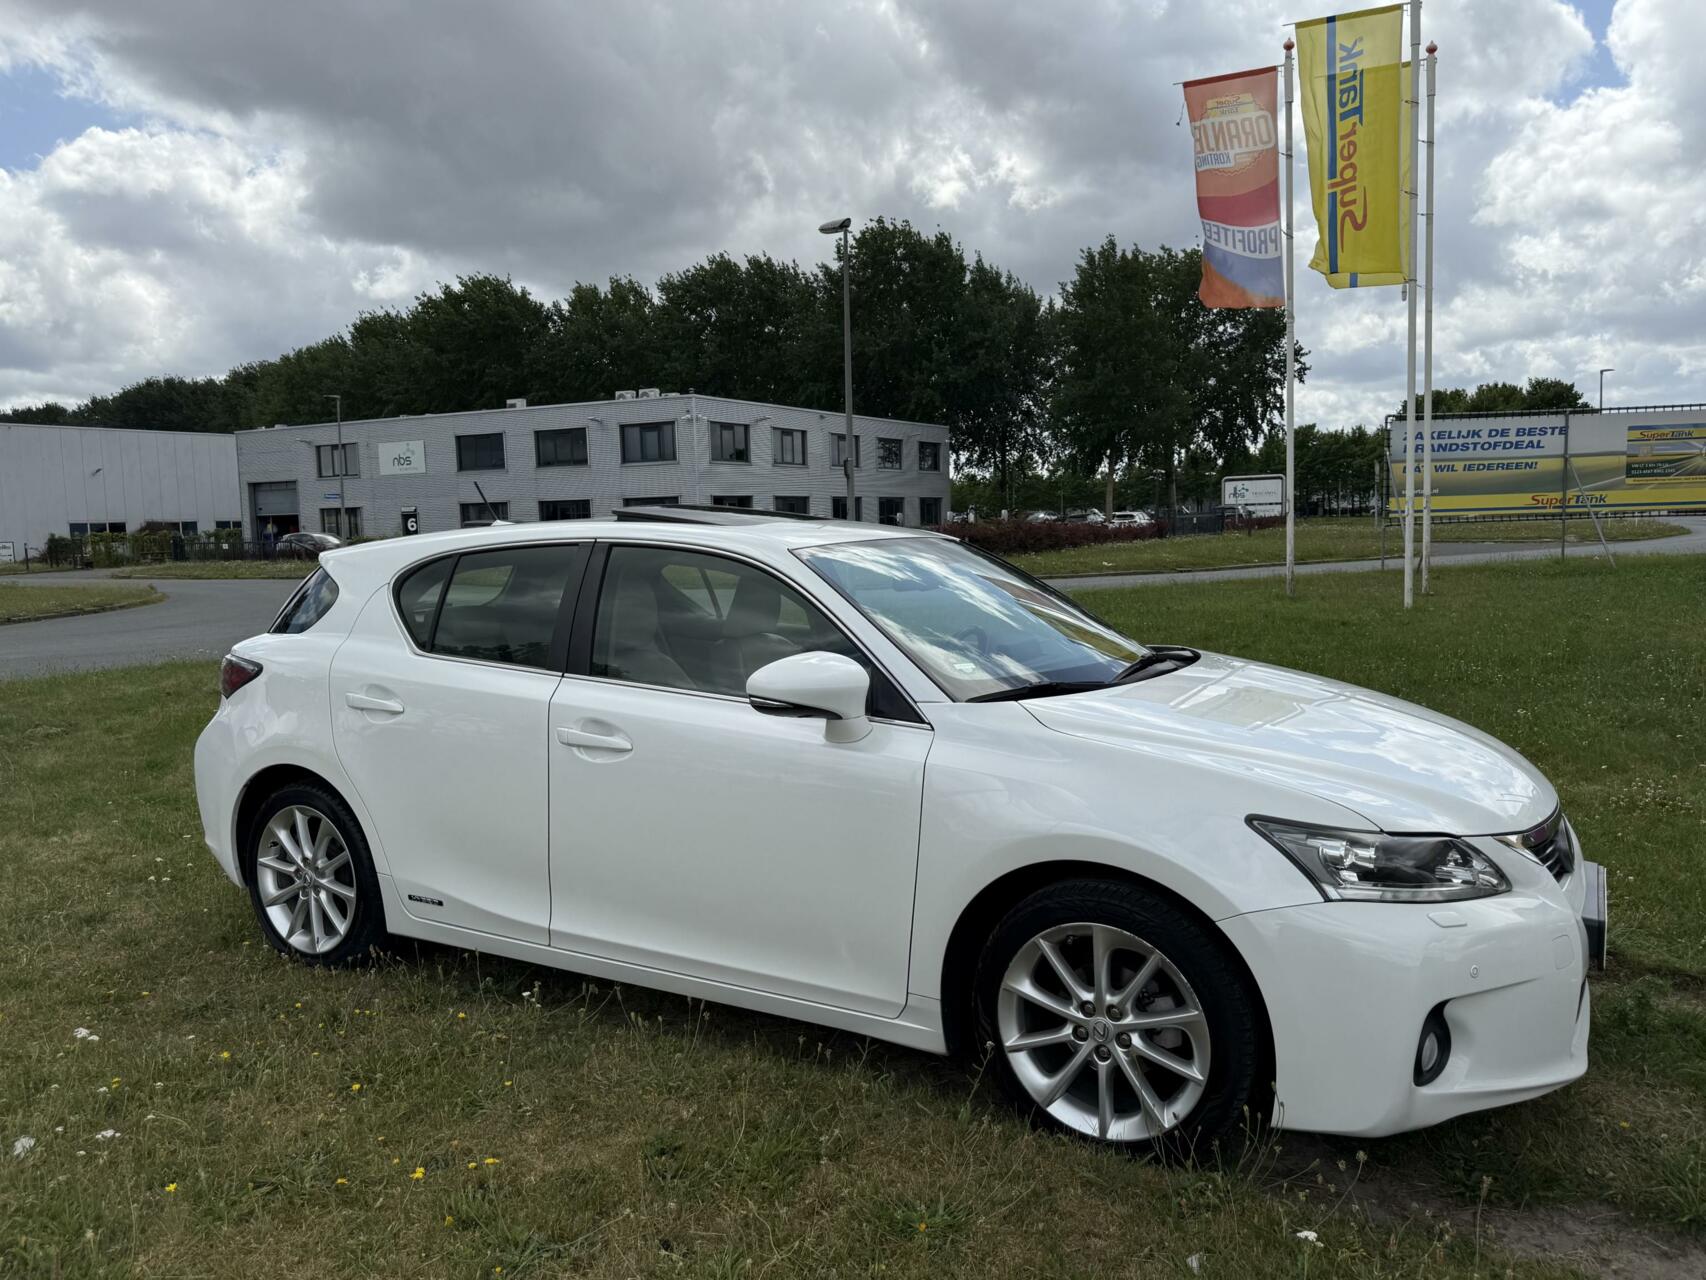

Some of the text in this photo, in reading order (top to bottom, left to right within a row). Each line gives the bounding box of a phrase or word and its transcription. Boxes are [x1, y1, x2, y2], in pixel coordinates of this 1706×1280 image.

[1487, 428, 1511, 438] DE
[1515, 426, 1569, 437] BESTE
[393, 453, 412, 467] nbs
[1434, 464, 1458, 473] WIL
[1462, 461, 1539, 472] IEDEREEN!
[407, 518, 417, 531] 6
